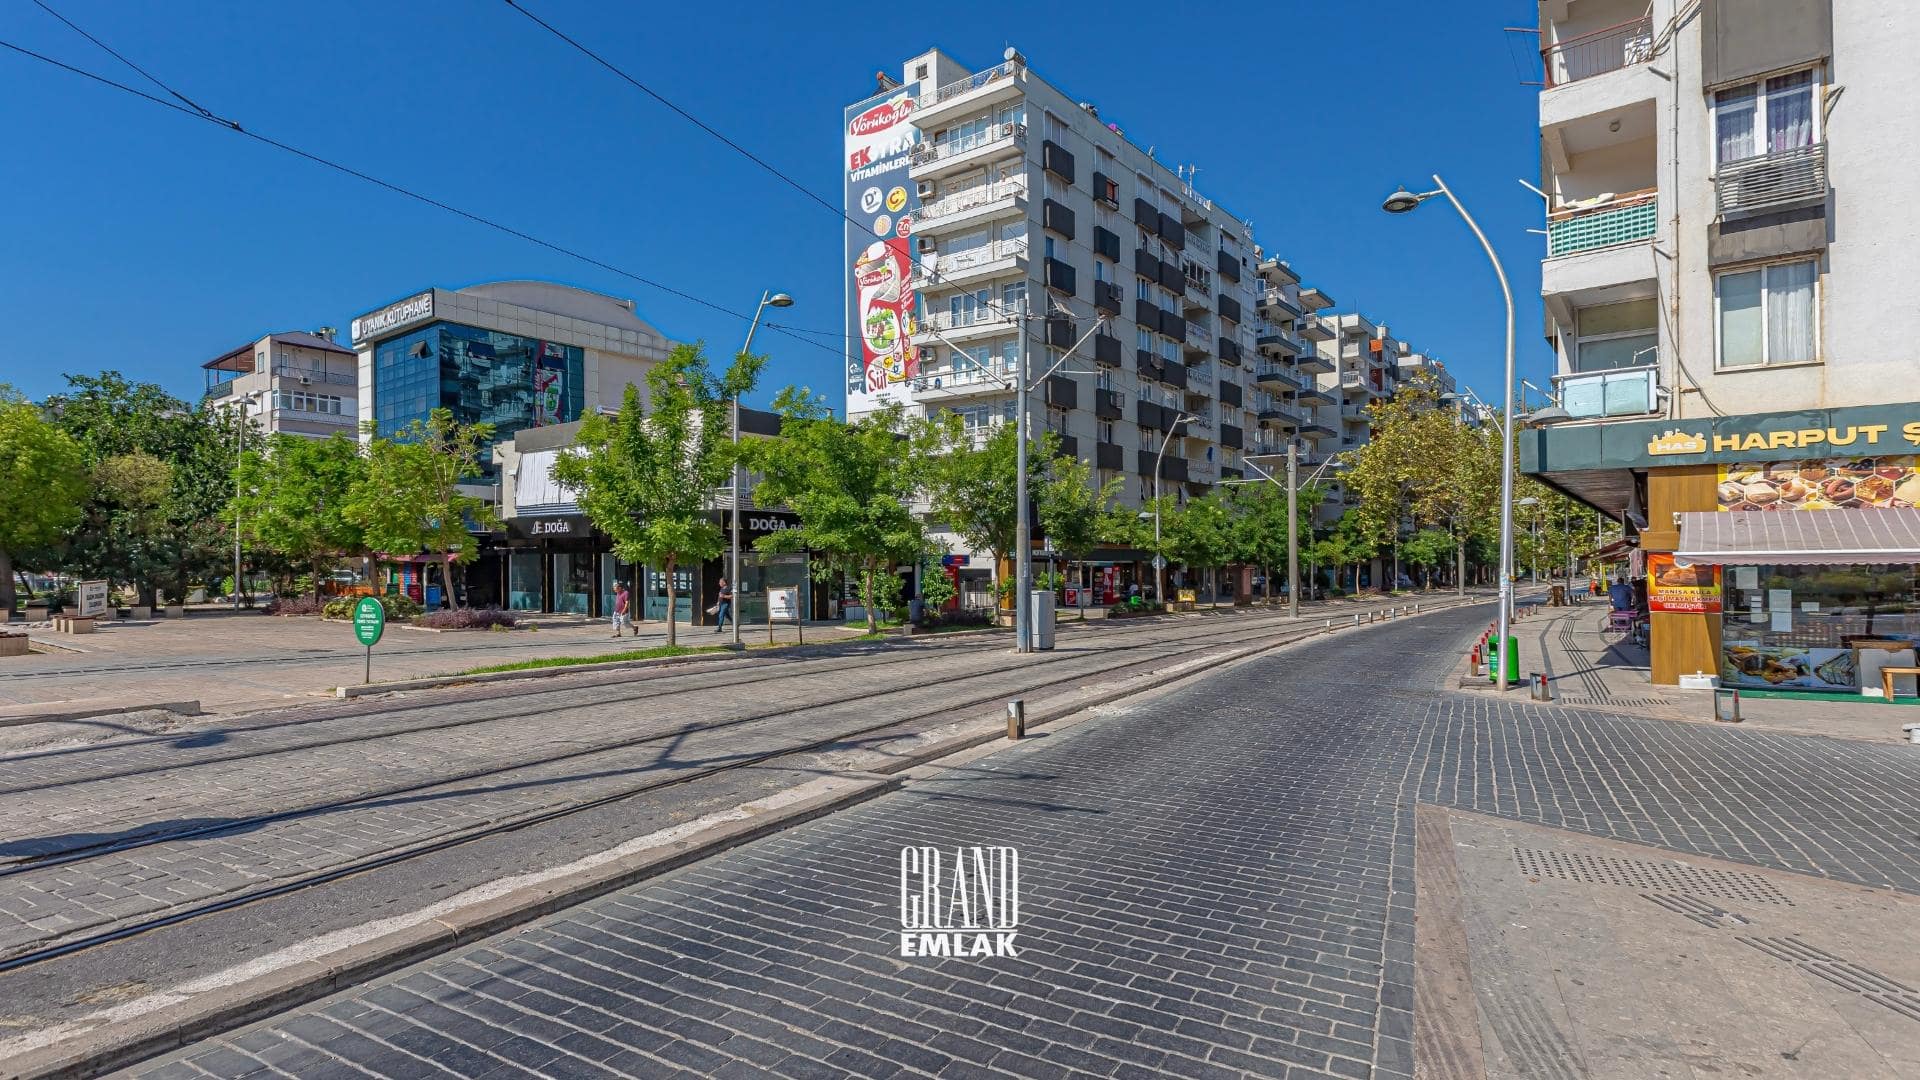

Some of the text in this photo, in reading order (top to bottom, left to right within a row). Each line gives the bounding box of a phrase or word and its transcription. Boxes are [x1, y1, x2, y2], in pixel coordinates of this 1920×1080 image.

[1713, 424, 1888, 452] HARPUT
[1657, 441, 1696, 451] HAS
[544, 518, 569, 533] DOĞA
[749, 515, 788, 531] DOĞA
